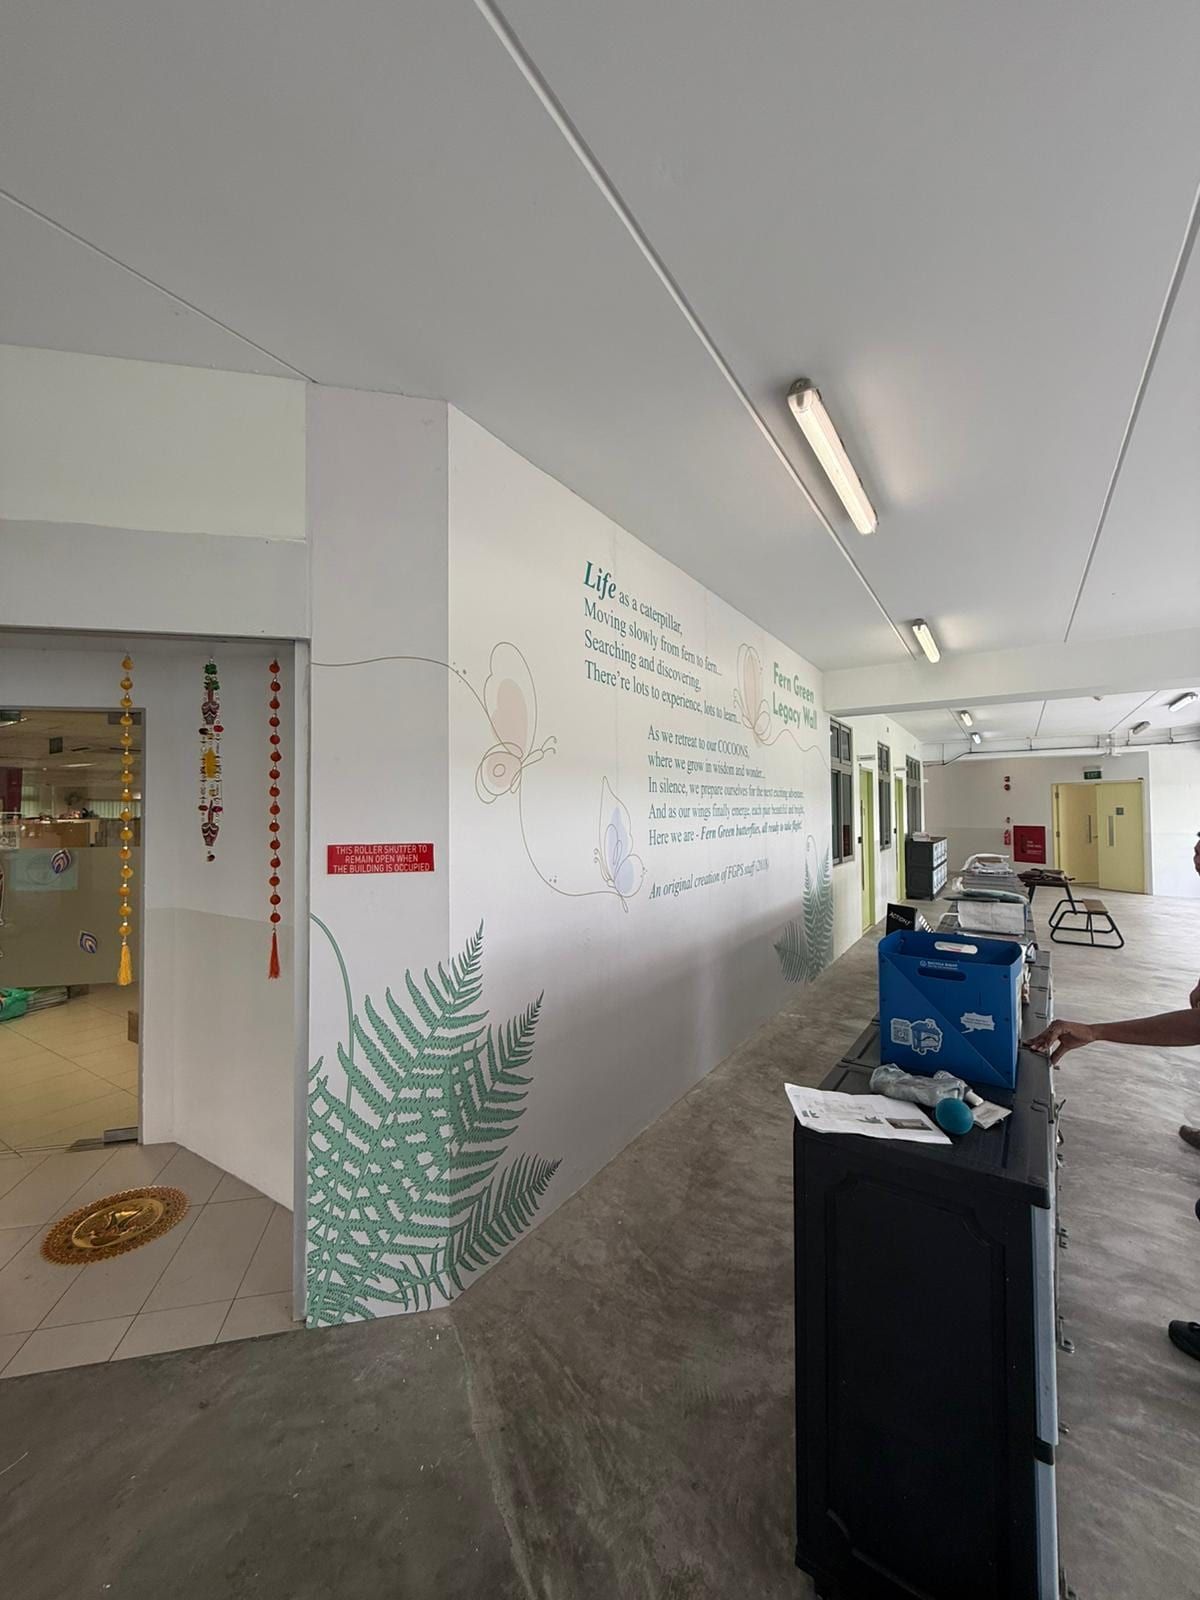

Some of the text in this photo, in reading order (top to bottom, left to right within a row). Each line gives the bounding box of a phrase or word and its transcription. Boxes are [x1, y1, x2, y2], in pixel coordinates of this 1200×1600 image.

[584, 560, 682, 637] Life as a caterpillar,
[584, 598, 626, 637] Moving
[629, 621, 658, 651] slowly
[661, 635, 679, 657] from
[681, 645, 695, 664] fern
[696, 656, 703, 667] to
[584, 629, 636, 669] Searching
[639, 656, 654, 672] and
[585, 660, 630, 691] There're
[634, 676, 649, 697] lots
[651, 686, 660, 700] to
[704, 700, 715, 717] lots
[717, 708, 722, 718] to
[773, 662, 814, 704] Fern Green
[773, 691, 817, 730] Legacy Wall
[648, 725, 659, 741] As
[661, 731, 673, 743] we
[675, 733, 697, 748] retreat
[699, 737, 705, 750] to
[706, 740, 717, 751] our
[648, 751, 672, 768] where
[674, 757, 685, 769] we
[687, 760, 704, 774] grow
[705, 759, 712, 772] in
[712, 760, 734, 775] wisdom
[735, 764, 744, 776] and
[648, 777, 657, 792] In
[660, 777, 688, 796] silence,
[689, 784, 699, 794] we
[701, 784, 723, 798] prepare
[724, 783, 748, 796] ourselves
[648, 803, 666, 819] And
[668, 807, 677, 818] as
[678, 807, 690, 818] our
[692, 803, 711, 821] wings
[712, 803, 730, 819] finally
[649, 829, 669, 845] Here
[670, 832, 682, 842] we
[684, 831, 694, 841] are
[701, 826, 716, 840] Fern
[718, 825, 735, 838] Green
[336, 845, 427, 855] THIS ROLLER SHUTTER TO
[345, 854, 418, 863] REMAIN OPEN WHEN
[333, 863, 429, 873] THE BUILDING IS OCCUPIED
[648, 882, 661, 899] An
[663, 874, 693, 897] original
[694, 871, 720, 887] creation
[721, 866, 728, 884] of
[728, 863, 744, 880] FGPS
